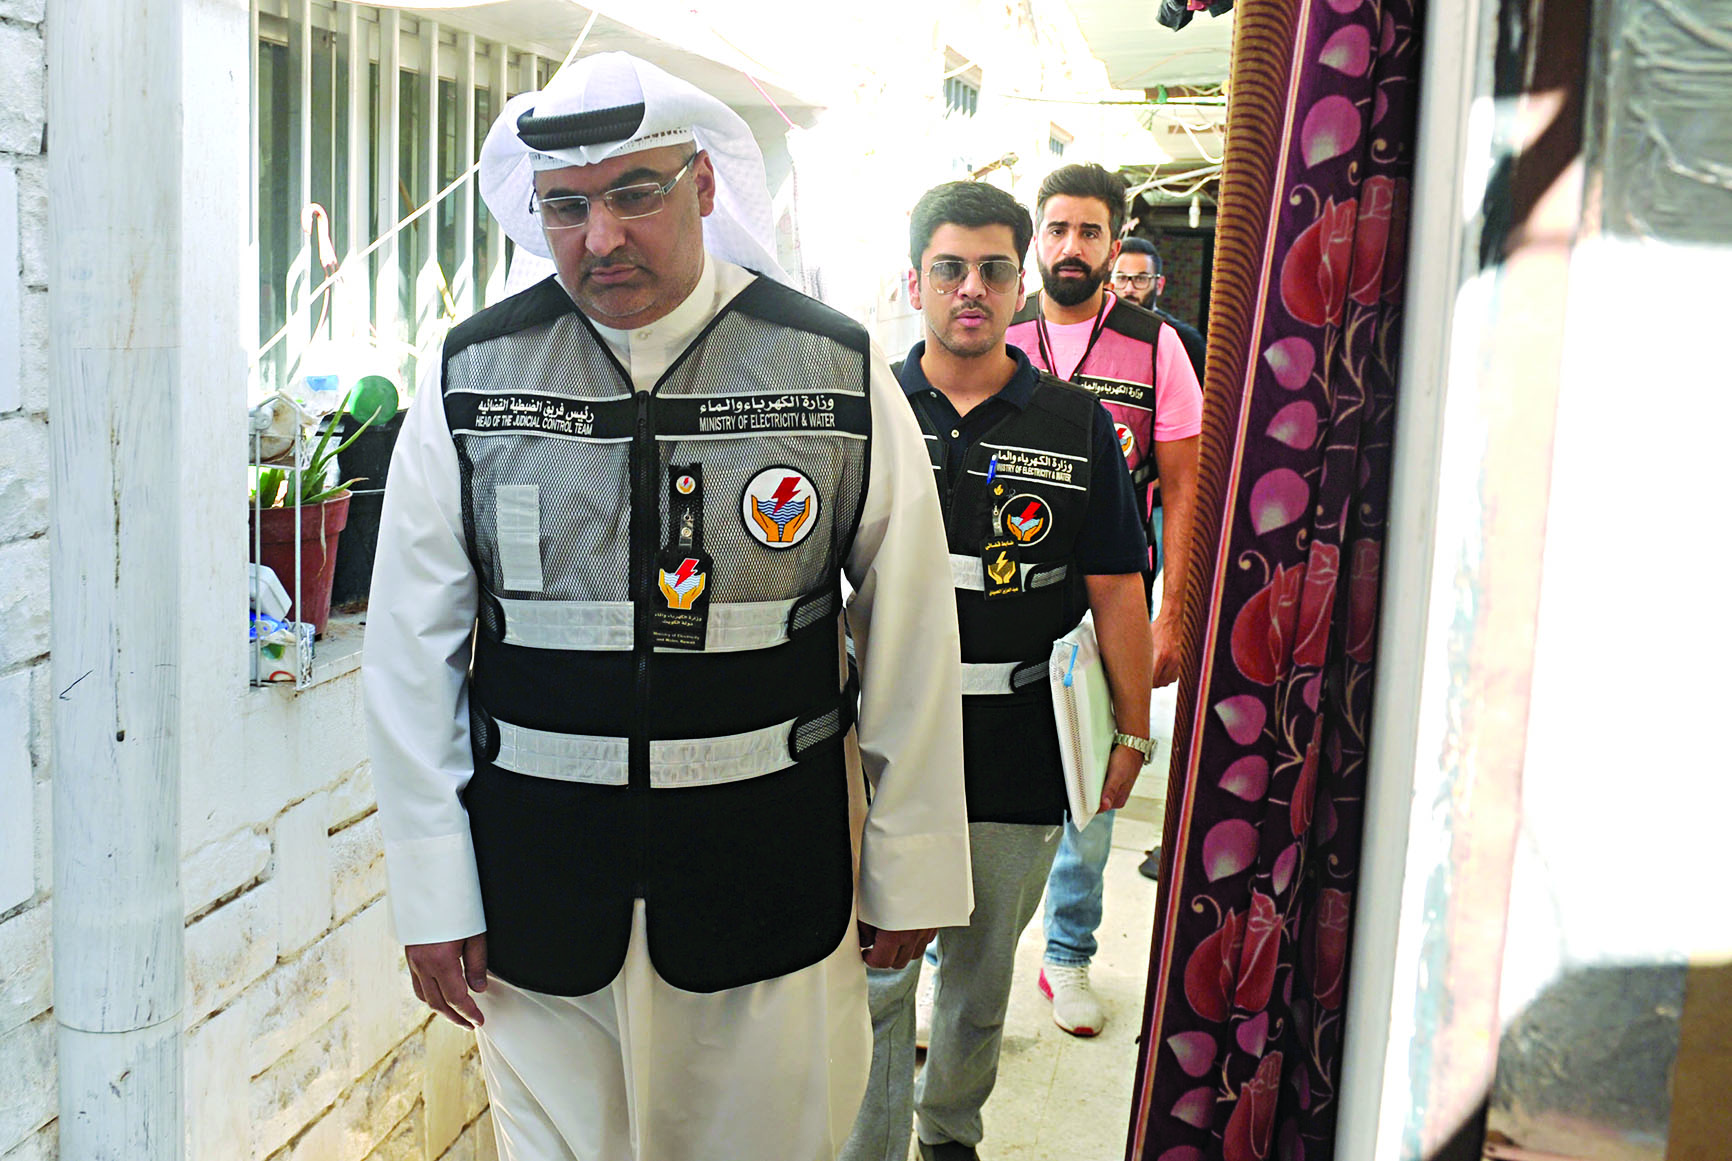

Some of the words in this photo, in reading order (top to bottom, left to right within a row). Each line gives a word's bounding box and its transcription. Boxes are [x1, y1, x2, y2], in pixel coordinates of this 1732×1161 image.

[510, 398, 543, 414] الضبطية
[543, 401, 564, 418] فريق
[802, 395, 834, 410] وزارة
[565, 405, 594, 423] رئيس
[475, 415, 492, 427] HEAD
[493, 416, 501, 427] OF
[502, 415, 513, 426] THE
[513, 415, 540, 428] JUDICIAL
[542, 418, 573, 433] CONTROL
[575, 423, 594, 436] TEAM
[700, 416, 737, 432] MINISTRY
[738, 415, 748, 430] OF
[750, 413, 800, 429] ELECTRICITY
[802, 415, 808, 426] &
[809, 413, 836, 428] WATER
[998, 450, 1016, 464] والما
[1052, 458, 1073, 472] وزارة
[1023, 466, 1052, 479] ELECTRICITY
